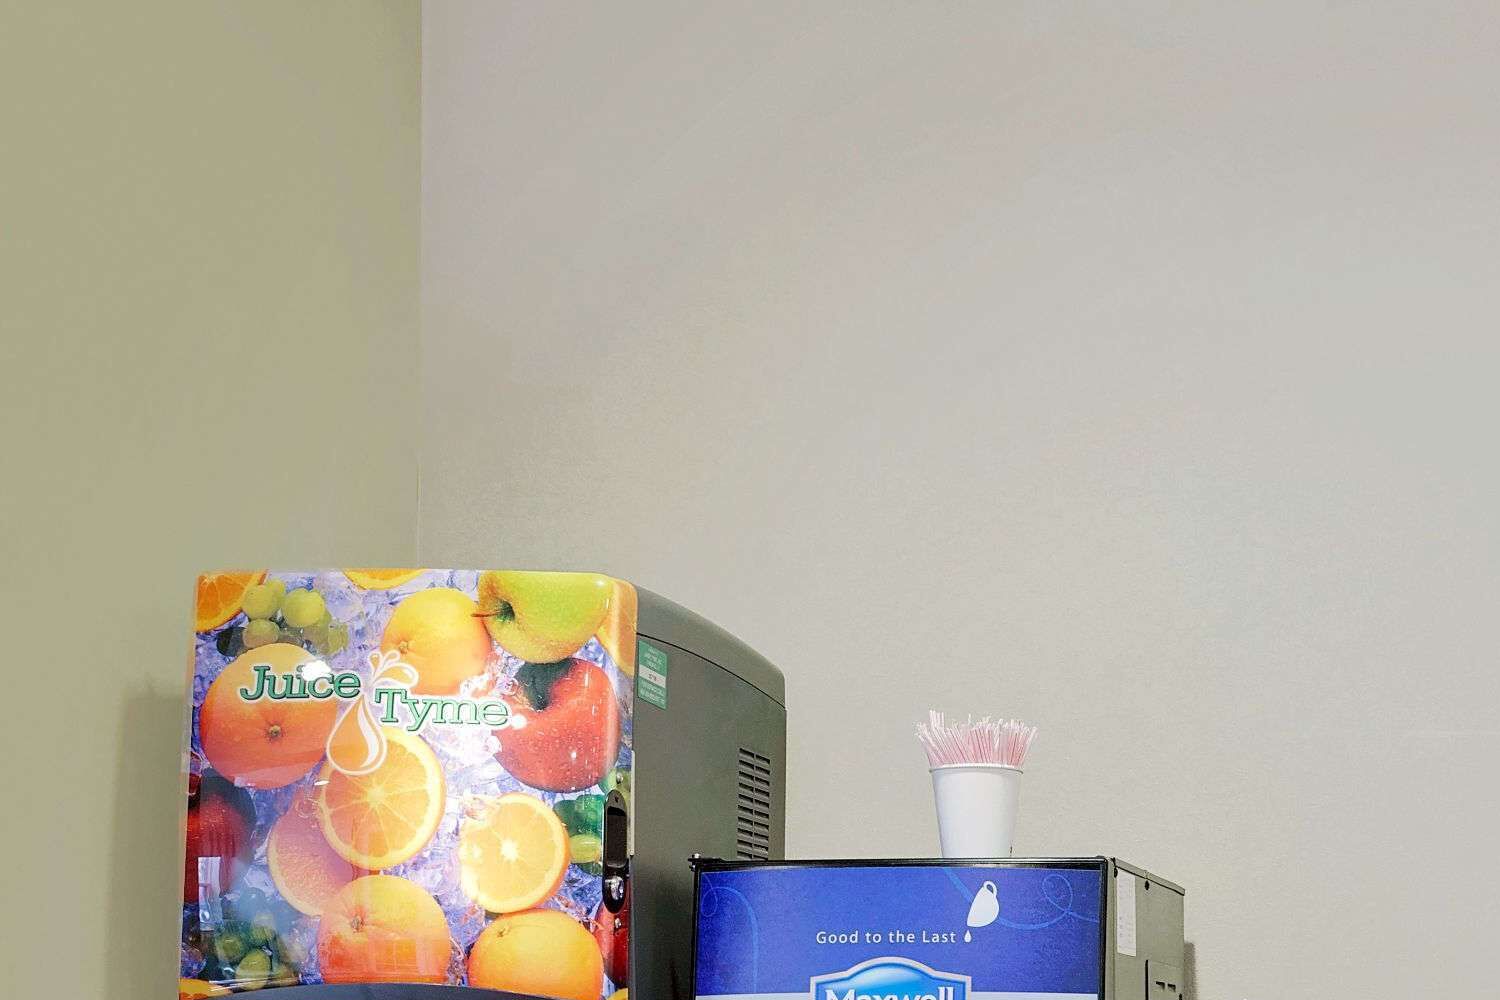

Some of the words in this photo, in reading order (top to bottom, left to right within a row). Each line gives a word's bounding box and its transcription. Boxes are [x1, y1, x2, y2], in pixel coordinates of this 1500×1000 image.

[240, 665, 361, 700] Juice
[374, 687, 509, 732] Tyme
[816, 930, 858, 944] Good
[865, 931, 882, 943] to
[889, 930, 915, 943] the
[922, 930, 957, 943] Last
